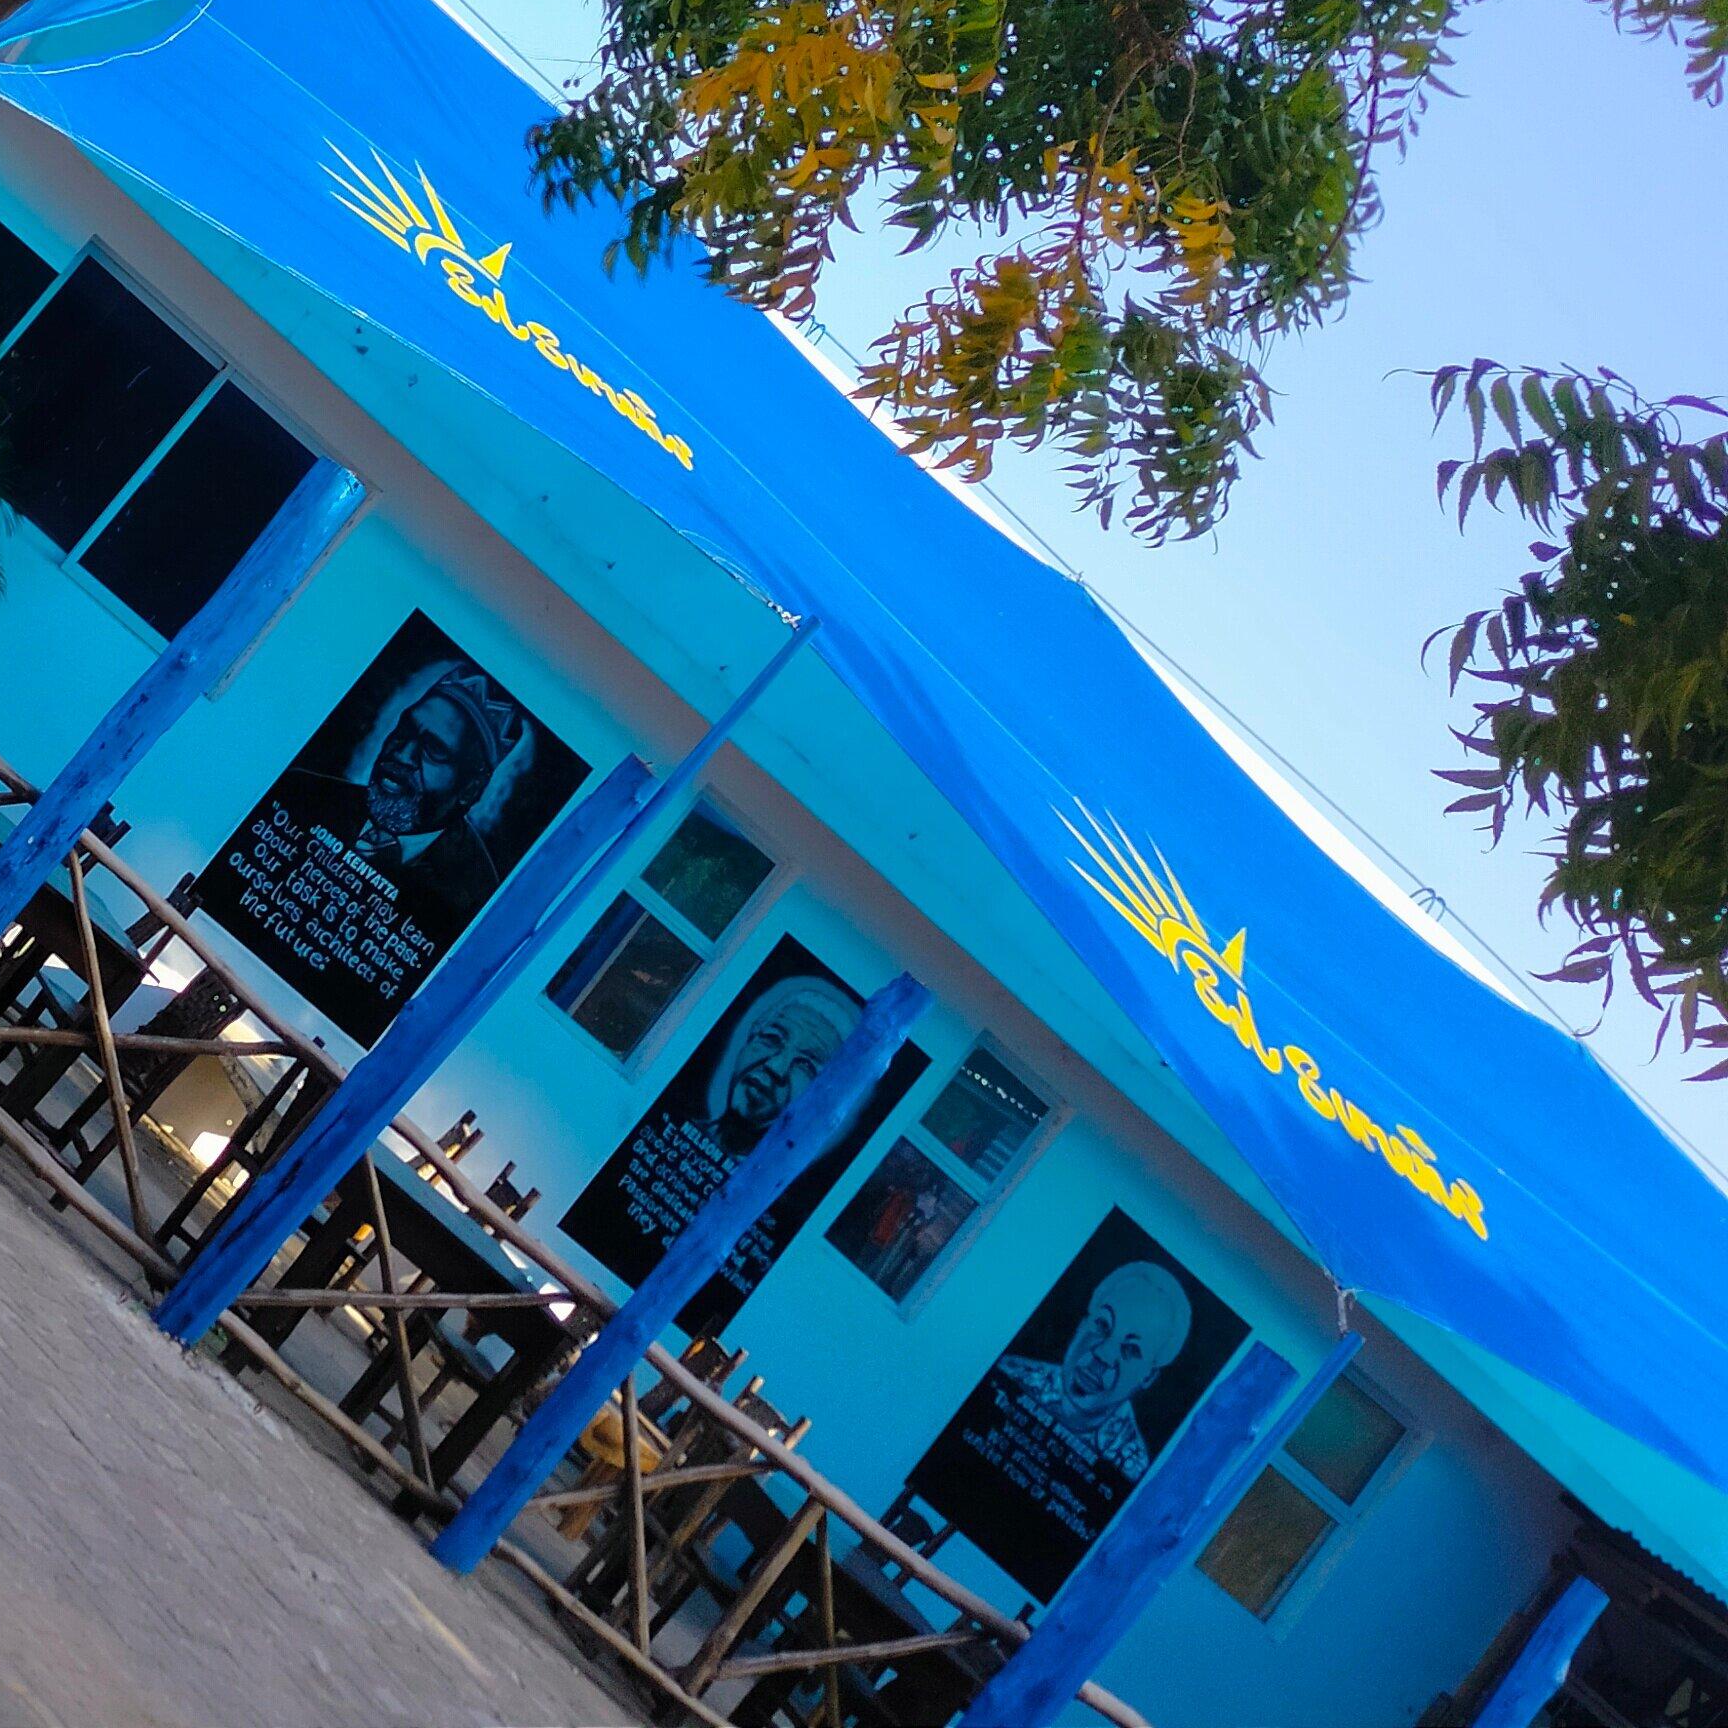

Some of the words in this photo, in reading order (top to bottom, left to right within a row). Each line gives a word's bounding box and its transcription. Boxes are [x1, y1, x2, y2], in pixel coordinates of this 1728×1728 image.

[251, 819, 297, 861] about
[300, 857, 349, 906] heroes
[345, 900, 365, 918] of
[363, 911, 388, 940] the
[382, 932, 421, 968] past.
[309, 824, 343, 854] JOMO
[342, 849, 398, 901] KENYATTA
[228, 851, 303, 922] ourselves
[305, 917, 376, 982] architects
[379, 980, 398, 999] of
[239, 886, 267, 918] the
[285, 868, 321, 908] task
[321, 900, 338, 922] is
[338, 914, 357, 941] to
[359, 938, 403, 981] make
[366, 893, 398, 924] may
[400, 915, 435, 956] learn
[629, 1158, 649, 1180] are
[632, 1138, 658, 1166] and
[655, 1163, 700, 1205] achieve
[678, 1158, 704, 1184] their
[680, 1121, 723, 1162] NELSON
[626, 1200, 657, 1234] they
